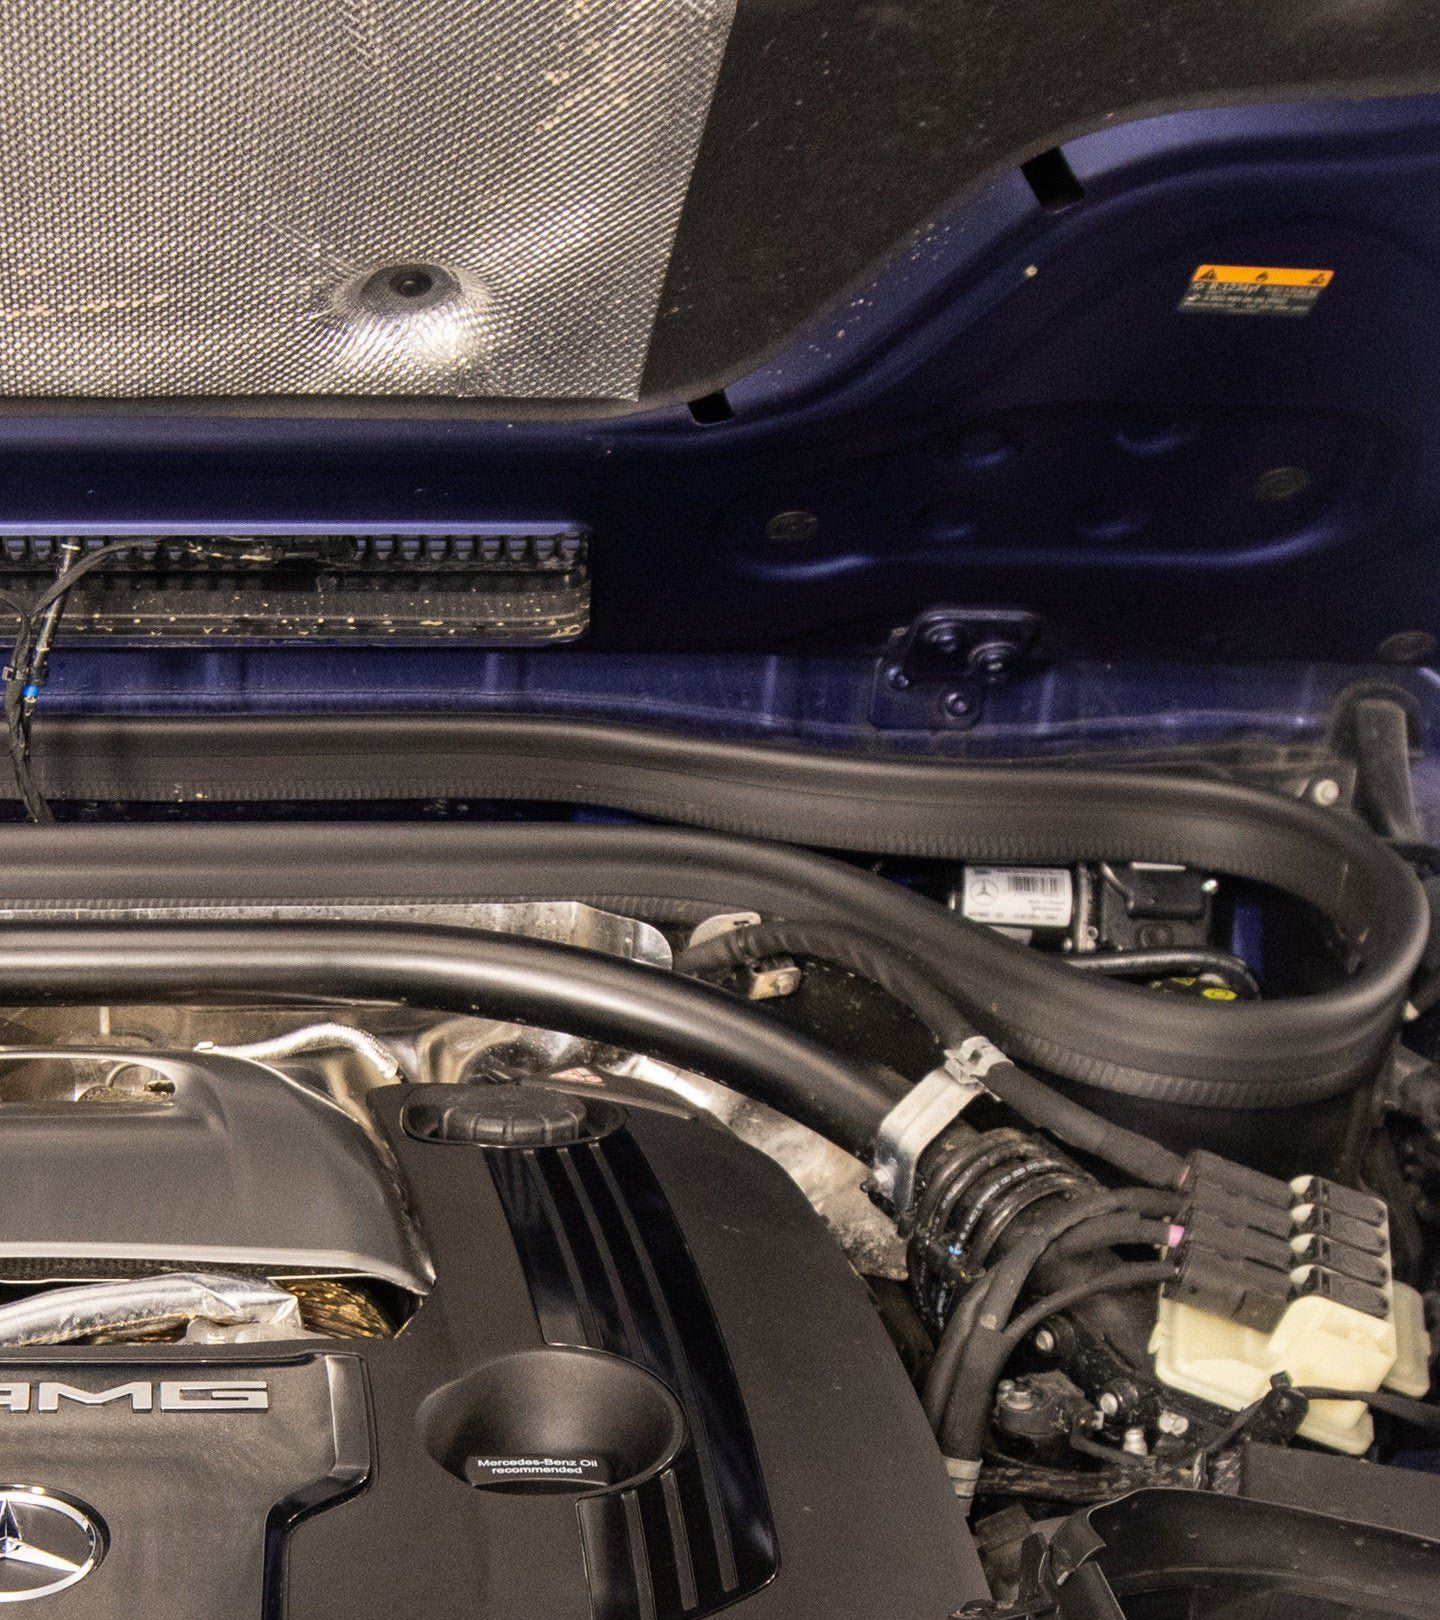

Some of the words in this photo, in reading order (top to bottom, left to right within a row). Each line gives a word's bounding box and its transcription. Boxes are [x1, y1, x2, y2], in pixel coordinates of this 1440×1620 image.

[477, 1458, 577, 1468] Mercedes-Benz
[580, 1458, 598, 1468] Oil
[491, 1465, 583, 1474] recommended
